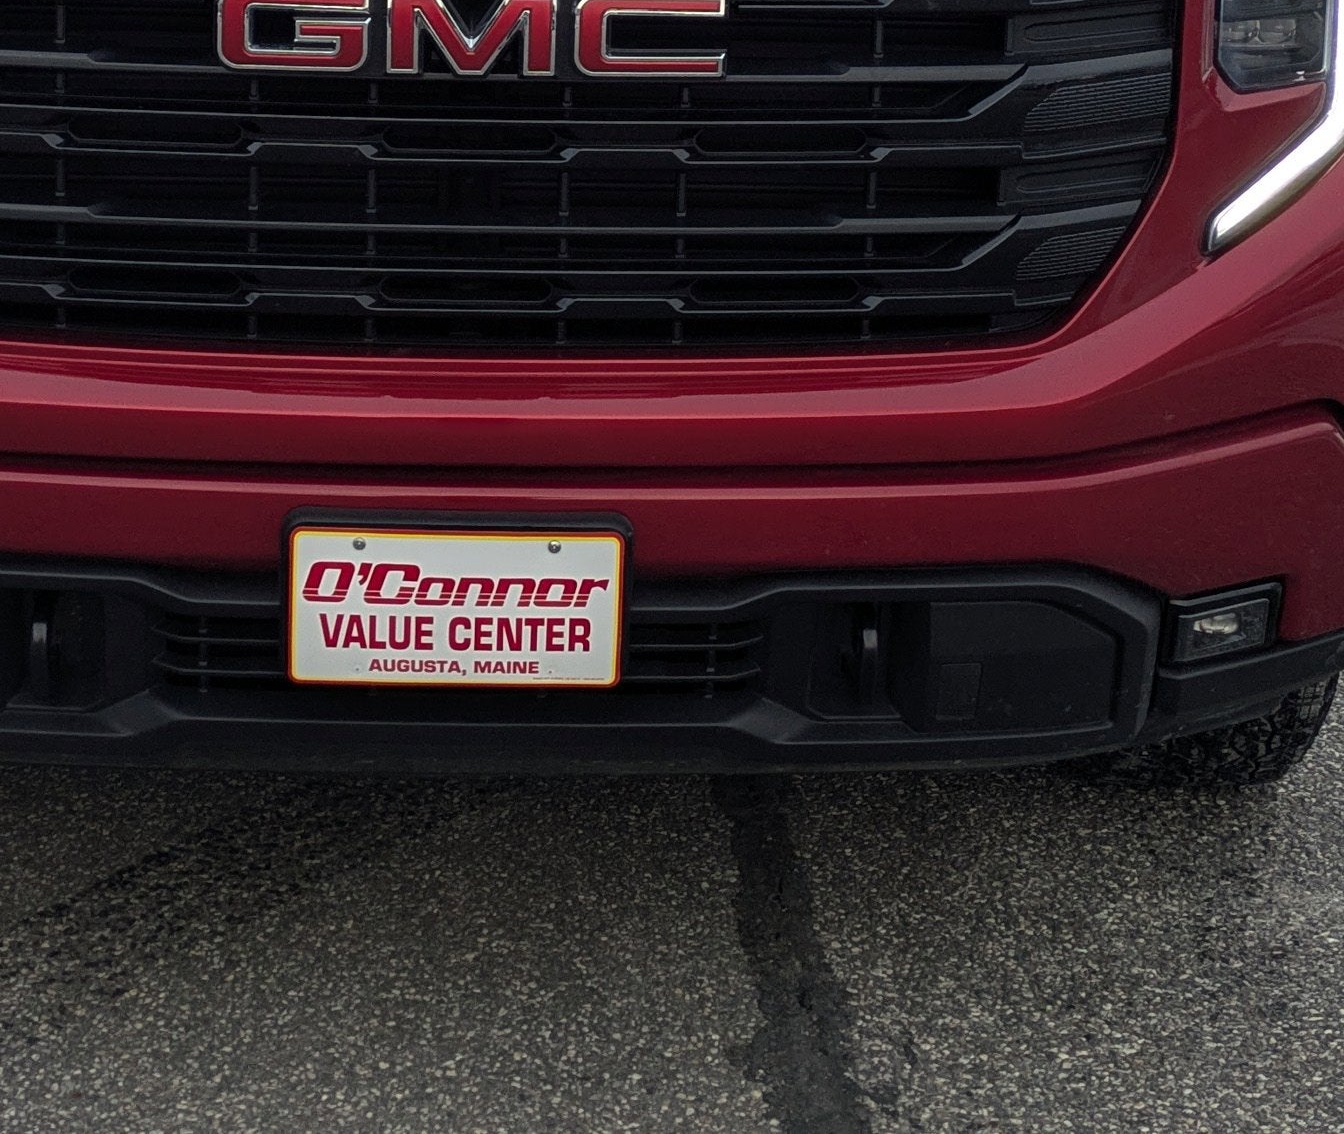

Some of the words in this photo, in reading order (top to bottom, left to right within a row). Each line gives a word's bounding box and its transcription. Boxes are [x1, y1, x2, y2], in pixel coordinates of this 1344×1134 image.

[301, 560, 610, 608] O'Connor
[318, 613, 435, 651] VALUE
[448, 616, 592, 653] CENTER
[368, 658, 468, 677] AUGUSTA,
[473, 660, 540, 675] MAINE
